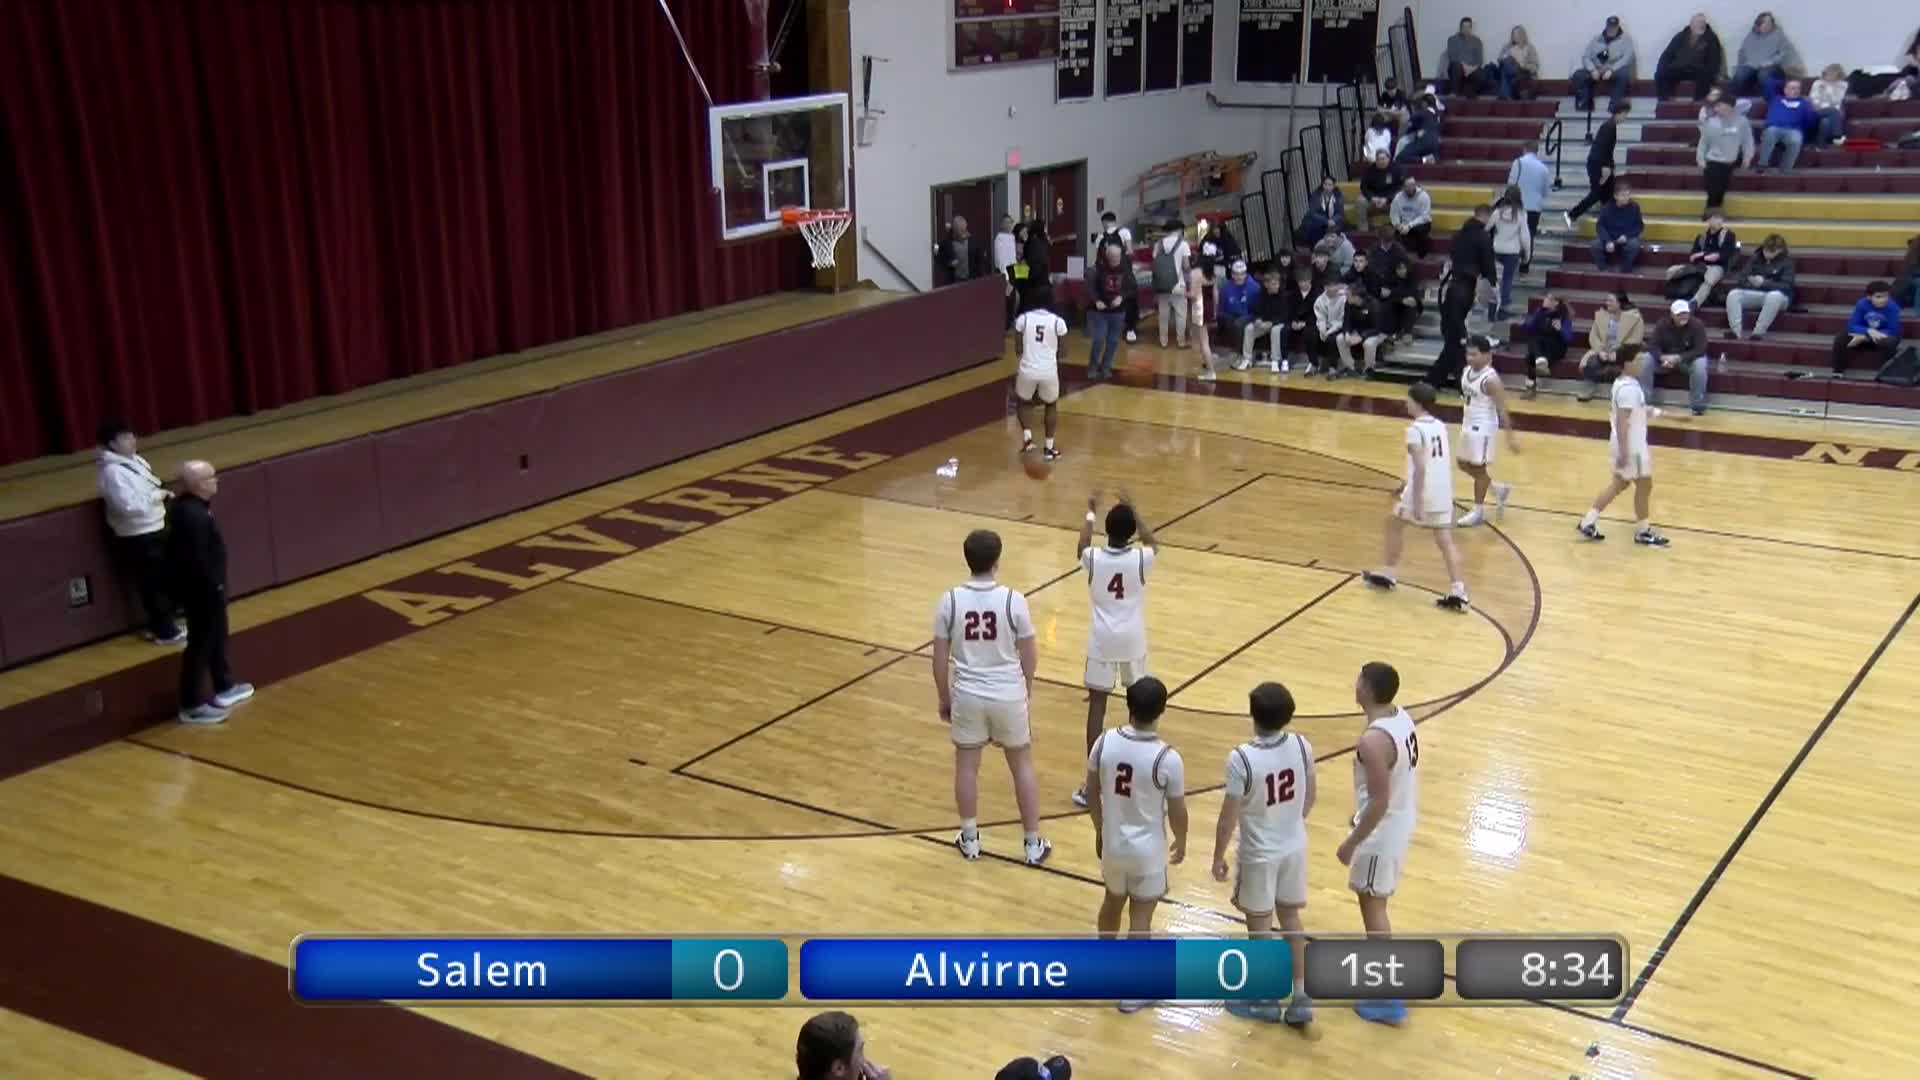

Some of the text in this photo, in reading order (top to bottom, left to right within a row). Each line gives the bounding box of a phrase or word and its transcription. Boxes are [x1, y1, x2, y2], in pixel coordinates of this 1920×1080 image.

[1035, 325, 1045, 343] 5
[361, 446, 892, 627] ALVIRNE
[1107, 572, 1125, 600] 4
[964, 611, 997, 641] 23
[1114, 763, 1133, 798] 2
[1265, 767, 1295, 806] 12
